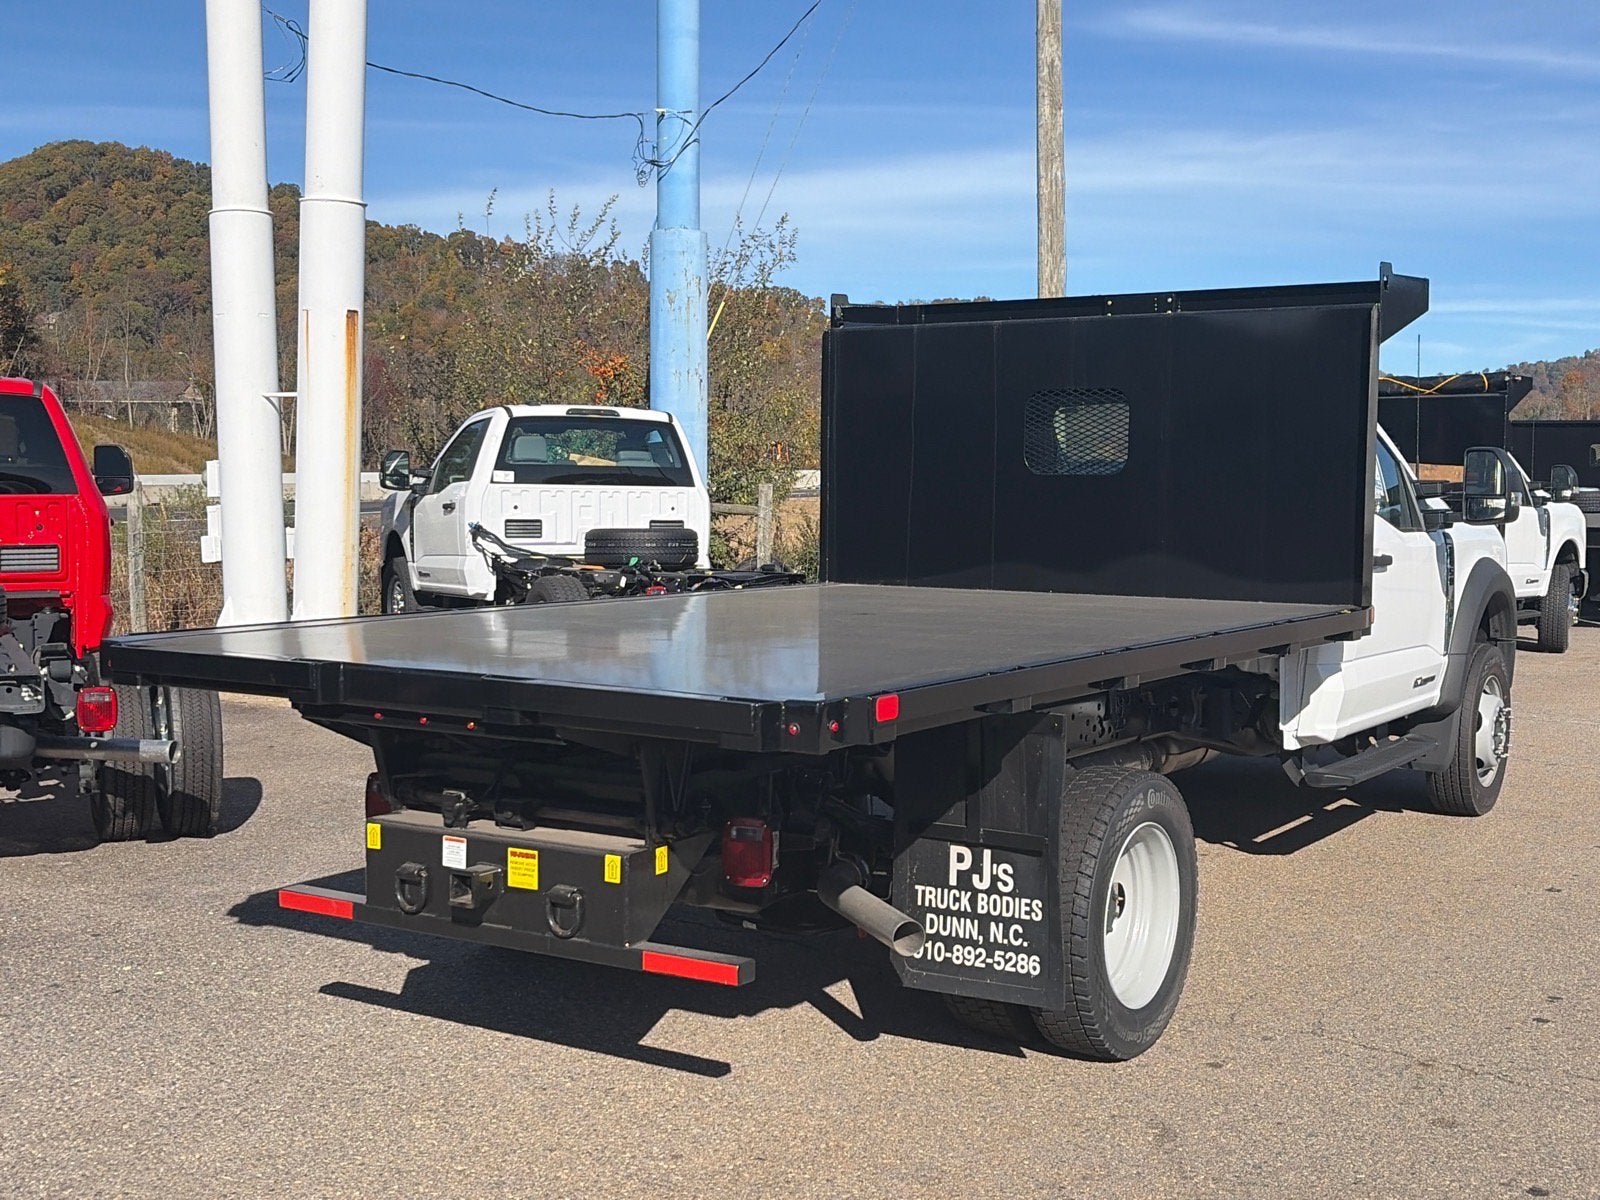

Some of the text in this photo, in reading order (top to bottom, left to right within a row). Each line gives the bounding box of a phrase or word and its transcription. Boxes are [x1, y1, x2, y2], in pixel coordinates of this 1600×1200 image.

[914, 884, 1043, 922] TRUCK BODIES
[925, 913, 1029, 947] DUNN, N.C.
